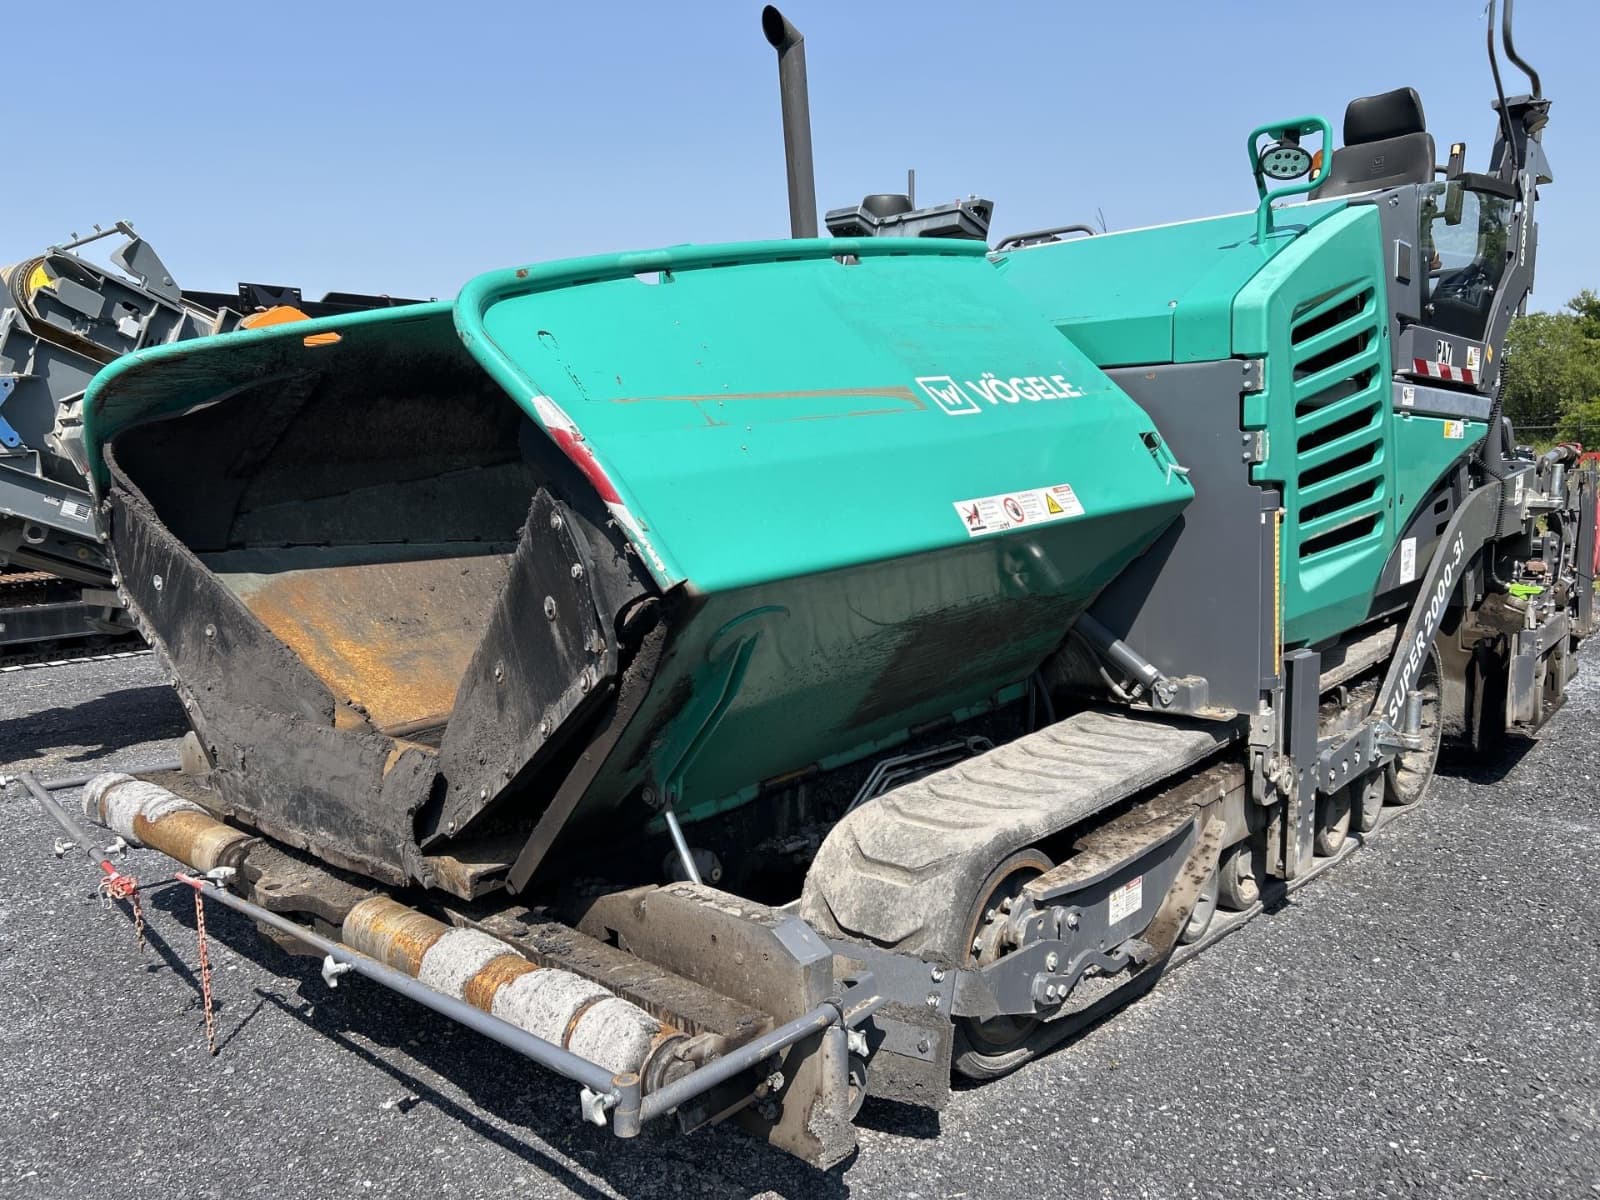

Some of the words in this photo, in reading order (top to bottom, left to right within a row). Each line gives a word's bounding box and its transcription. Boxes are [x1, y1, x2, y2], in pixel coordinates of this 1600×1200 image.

[965, 372, 1083, 404] VÖGELE
[1389, 629, 1427, 726] SUPER
[1424, 531, 1465, 637] 2000-3i
